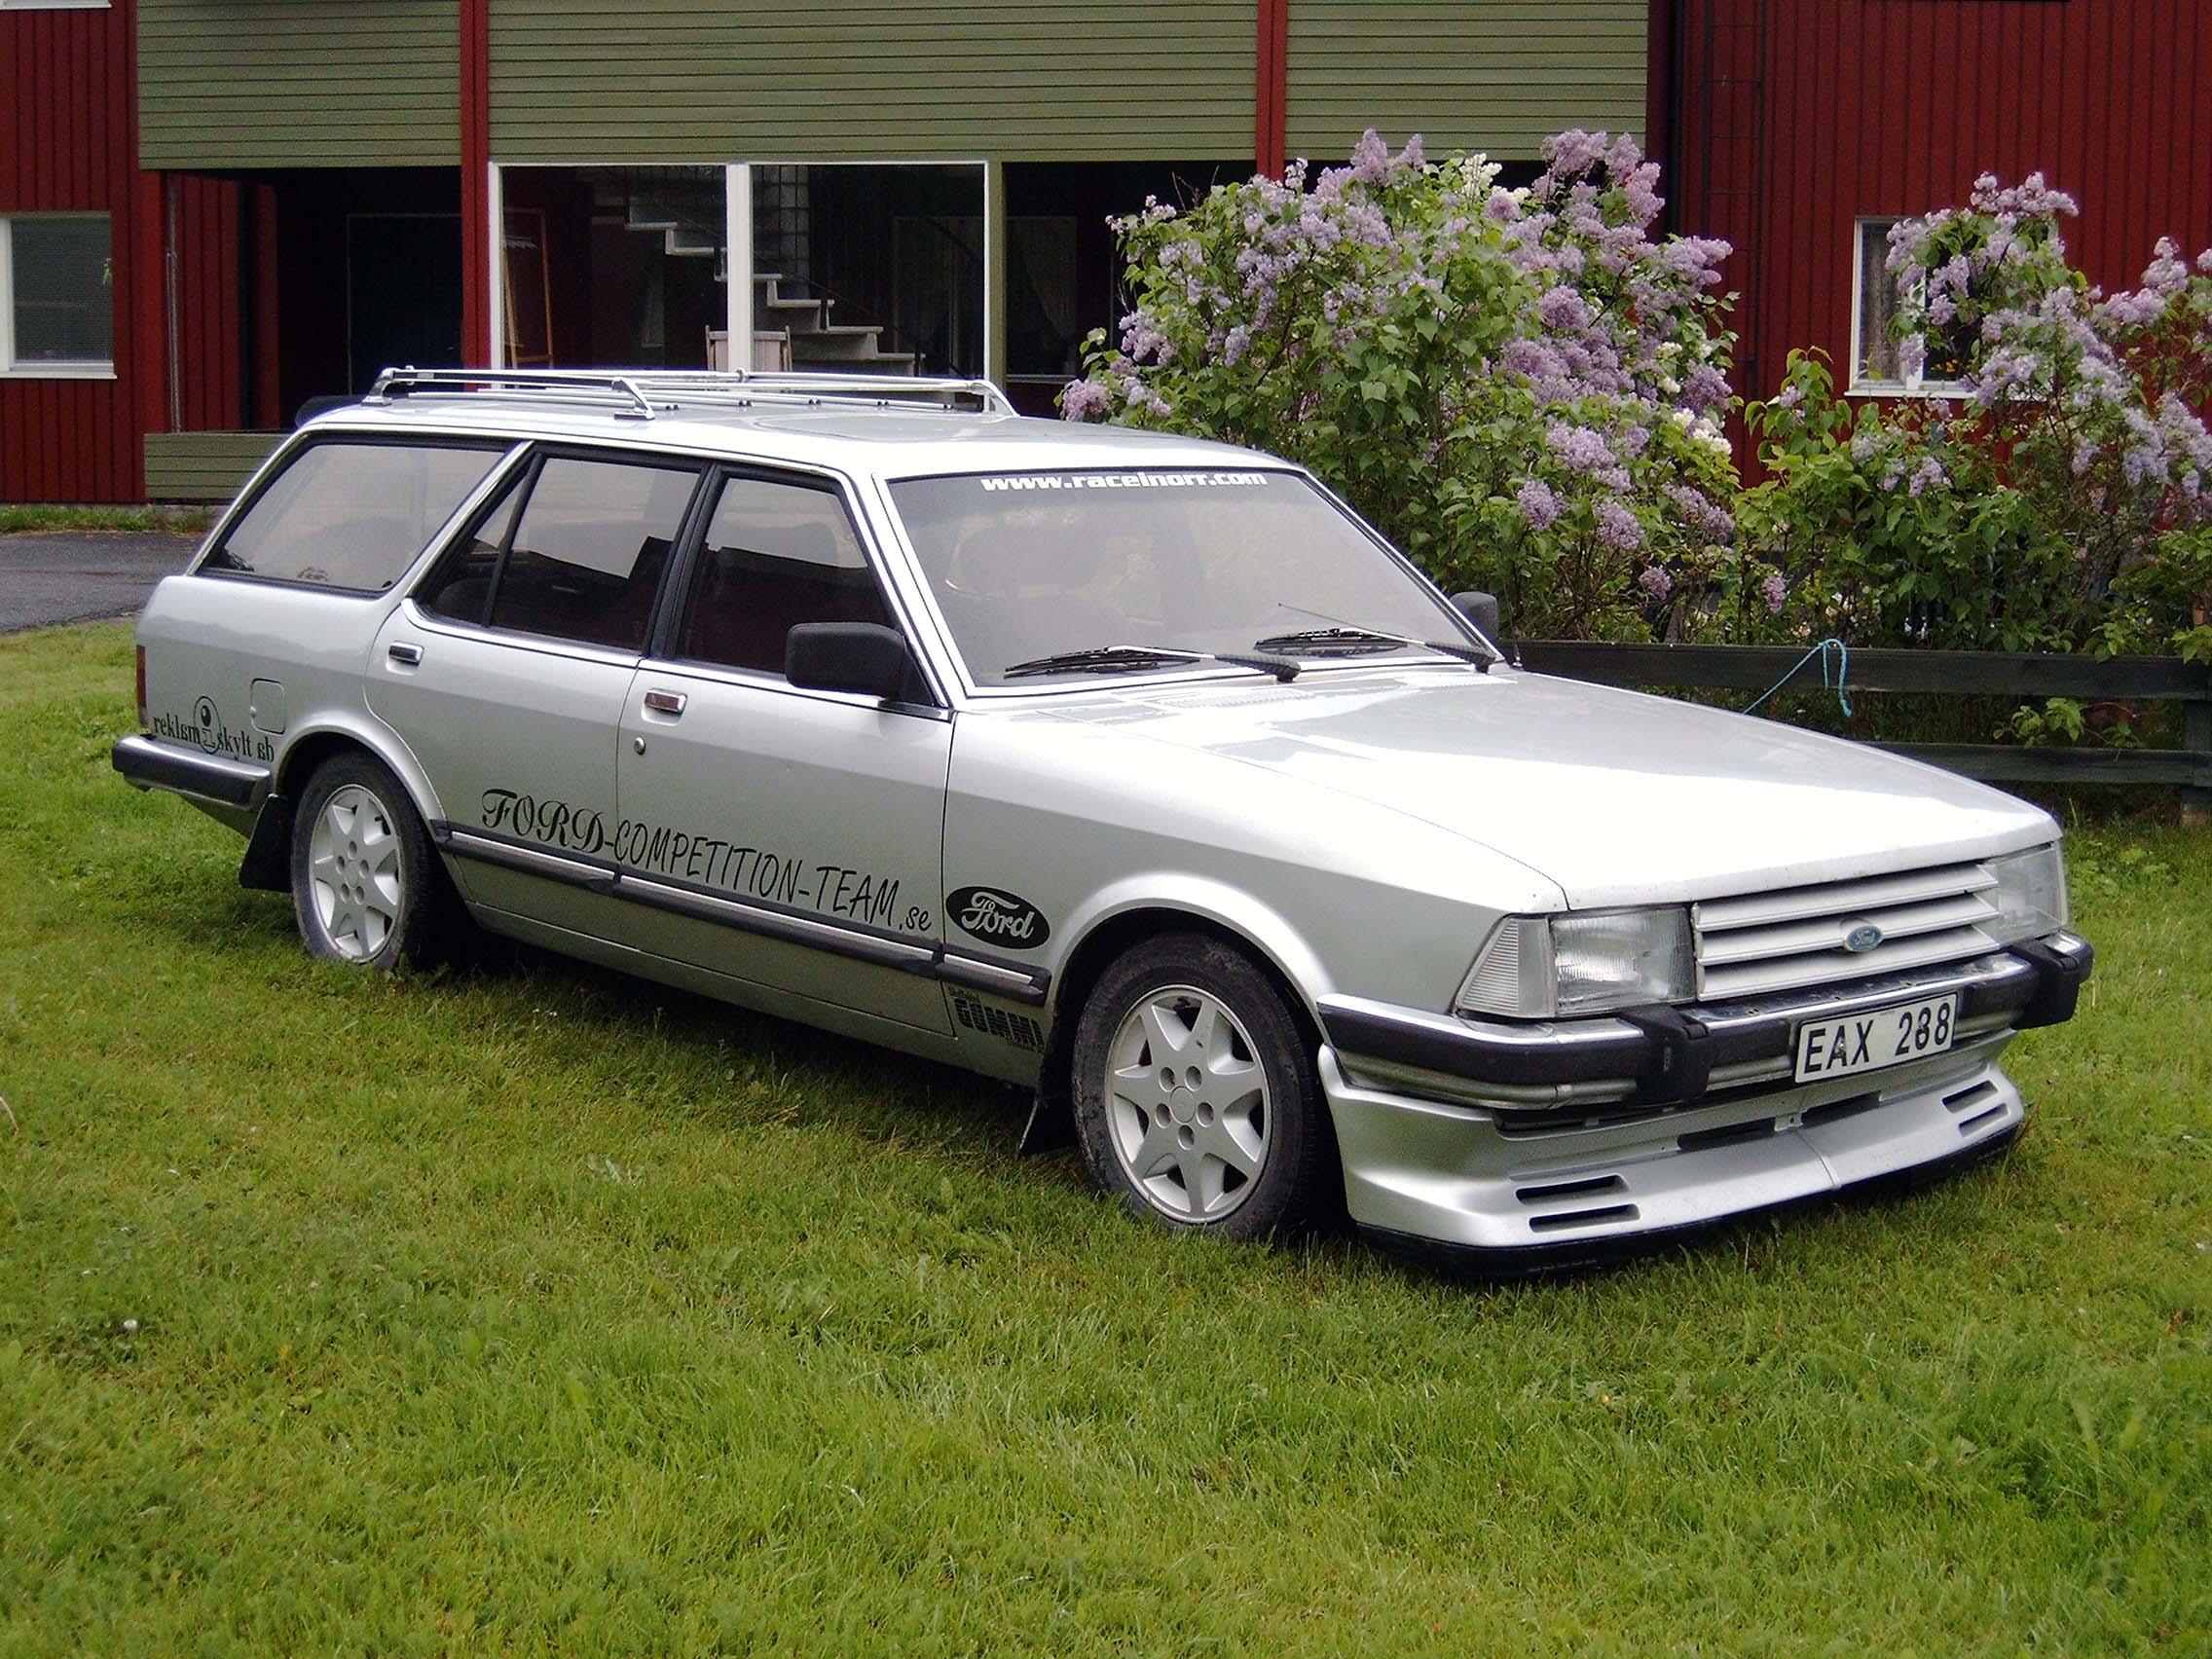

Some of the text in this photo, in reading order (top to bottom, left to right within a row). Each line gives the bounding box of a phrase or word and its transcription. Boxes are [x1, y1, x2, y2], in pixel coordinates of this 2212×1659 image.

[153, 713, 201, 744] reklam
[217, 725, 253, 760] skylt
[961, 891, 1036, 940] Ford
[1804, 1002, 1951, 1074] EAX 288
